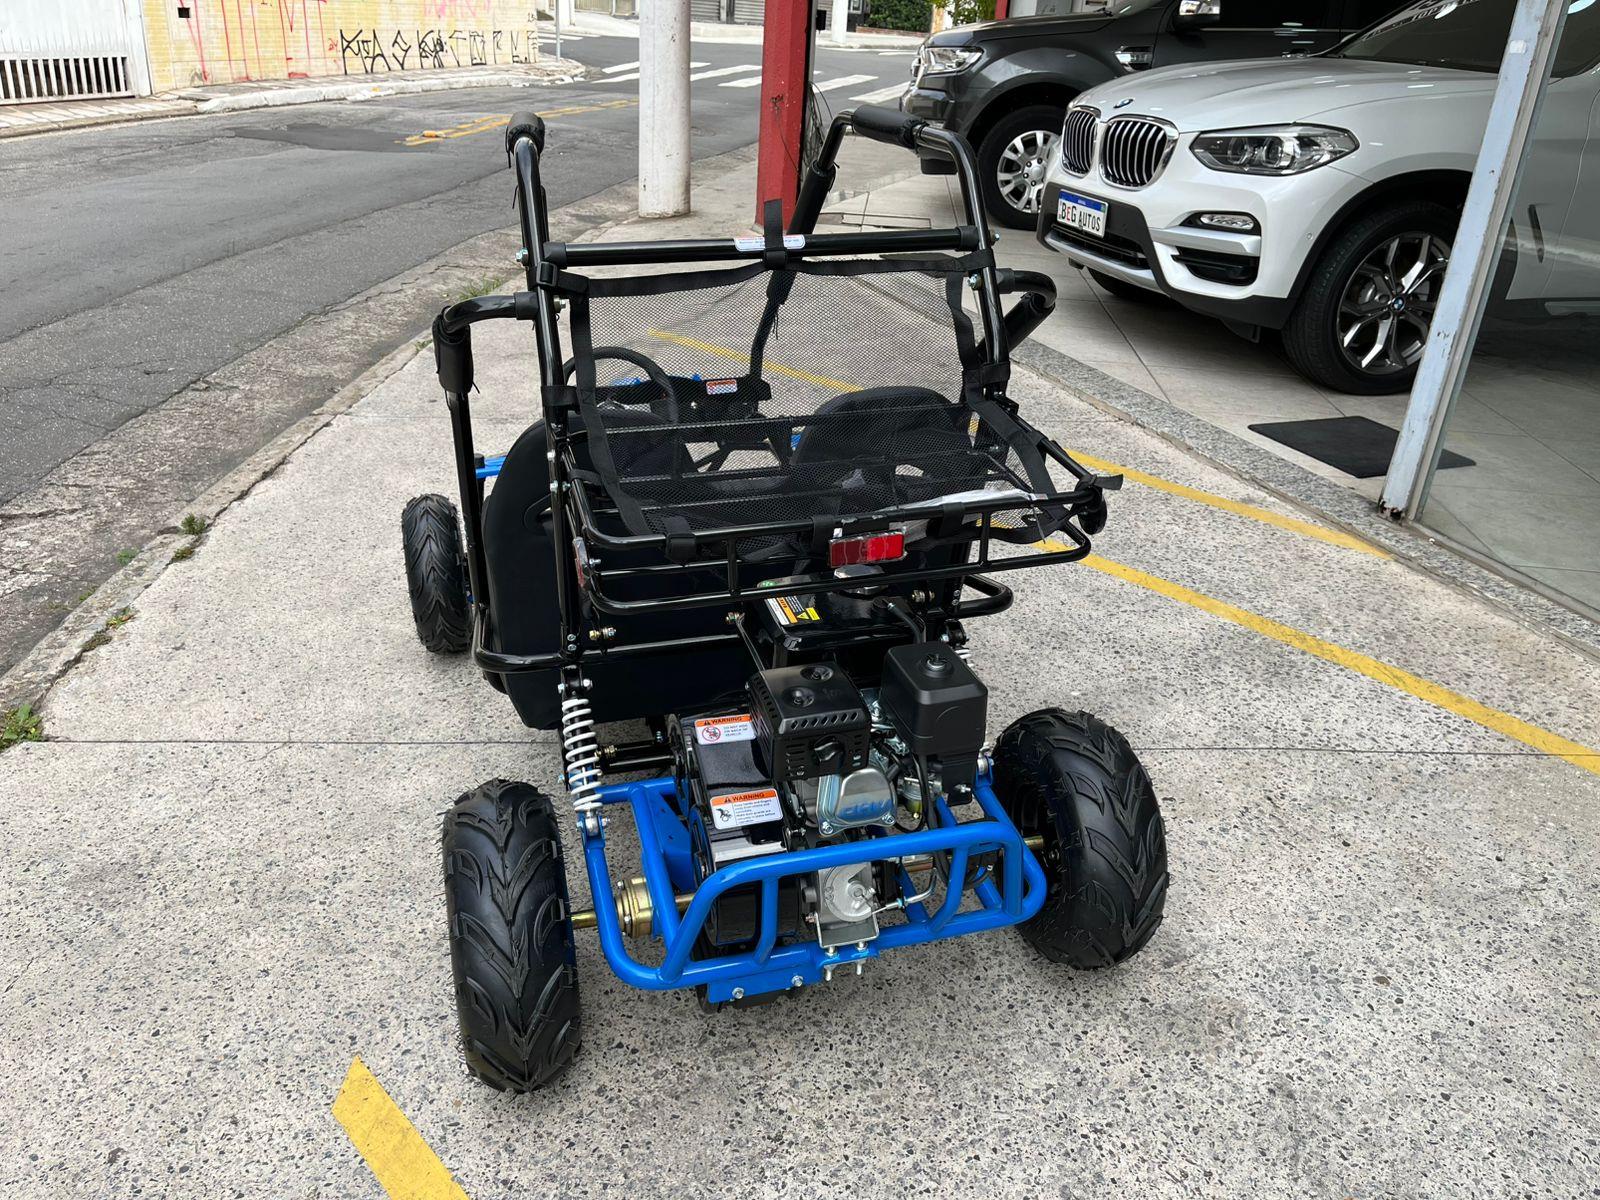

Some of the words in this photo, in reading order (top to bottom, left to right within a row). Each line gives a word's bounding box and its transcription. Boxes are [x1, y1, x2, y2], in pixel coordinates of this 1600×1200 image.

[1079, 211, 1101, 231] AUTOS
[711, 716, 742, 724] WARNING
[732, 793, 765, 802] WARNING
